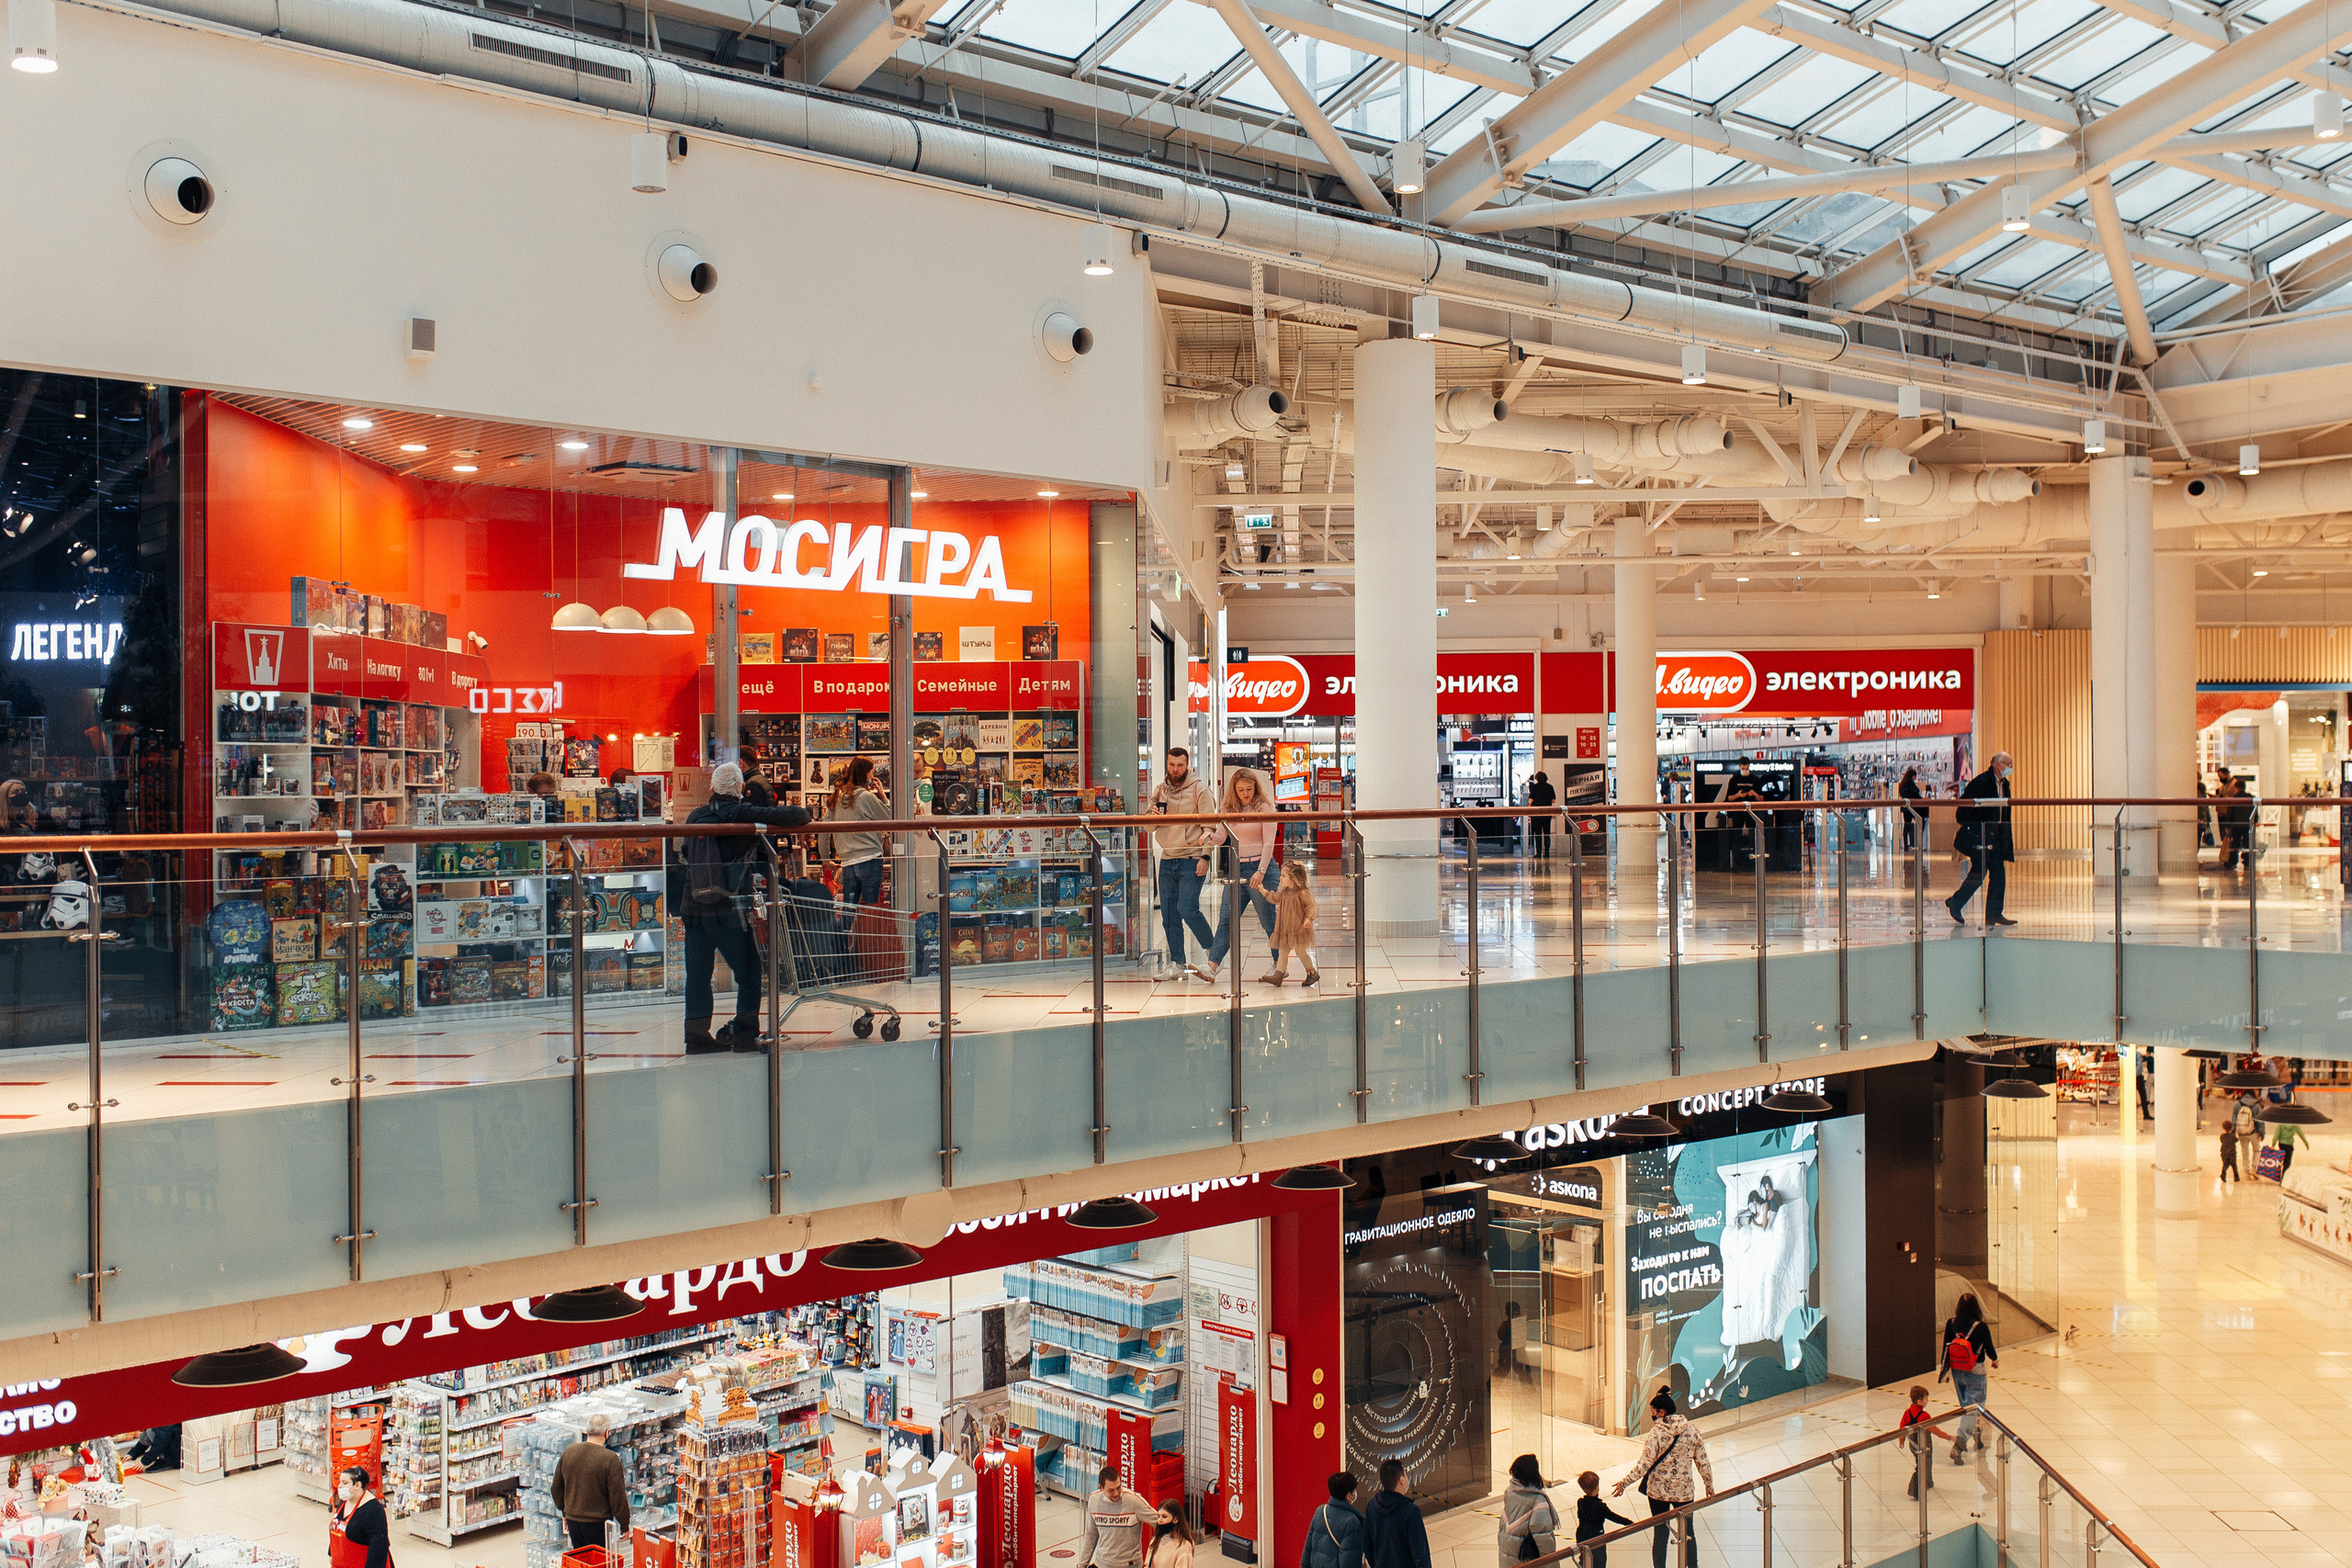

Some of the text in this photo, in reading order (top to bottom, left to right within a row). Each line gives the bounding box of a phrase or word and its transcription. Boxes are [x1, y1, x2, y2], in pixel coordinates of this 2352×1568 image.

[624, 507, 1033, 603] МОСИГРА
[327, 651, 348, 671] Хиты
[377, 660, 401, 682] логику
[457, 673, 478, 691] дорогу
[741, 681, 775, 696] ещё
[813, 680, 823, 694] В
[917, 679, 998, 693] Семейные
[1019, 678, 1071, 694] Детям
[1325, 672, 1519, 695] элоника
[1657, 663, 1744, 701] .видео
[1765, 669, 1962, 698] электроника
[1510, 721, 1534, 732] SAM
[1568, 773, 1600, 785] ЧЕРНАЯ
[957, 928, 975, 937] CATAN
[1678, 1086, 1765, 1116] CONCEPT
[1524, 1105, 1648, 1150] asko
[1549, 1179, 1598, 1201] askona
[1344, 1207, 1476, 1246] ГРАВИТАЦИОННОЕ ОДЕЯЛО
[1636, 1209, 1651, 1224] Вы
[1648, 1225, 1663, 1239] не
[1631, 1251, 1681, 1272] Заходите
[1690, 1246, 1710, 1259] нам
[1641, 1263, 1722, 1301] ПОСПАТЬ
[1363, 1390, 1419, 1424] БЫСТРОЕ ЗАСЫПАНИЕ
[1352, 1416, 1379, 1443] СНИЖЕНИЕ
[1403, 1396, 1439, 1441] ТРЕВОЖНОСТИ
[1228, 1404, 1238, 1493] Леонардо
[1365, 1462, 1378, 1472] СОН
[1431, 1428, 1447, 1450] ВСЕЙ
[1121, 1432, 1130, 1491] нардо
[1001, 1462, 1013, 1561] Леонардо
[1109, 1516, 1130, 1524] SPORTY
